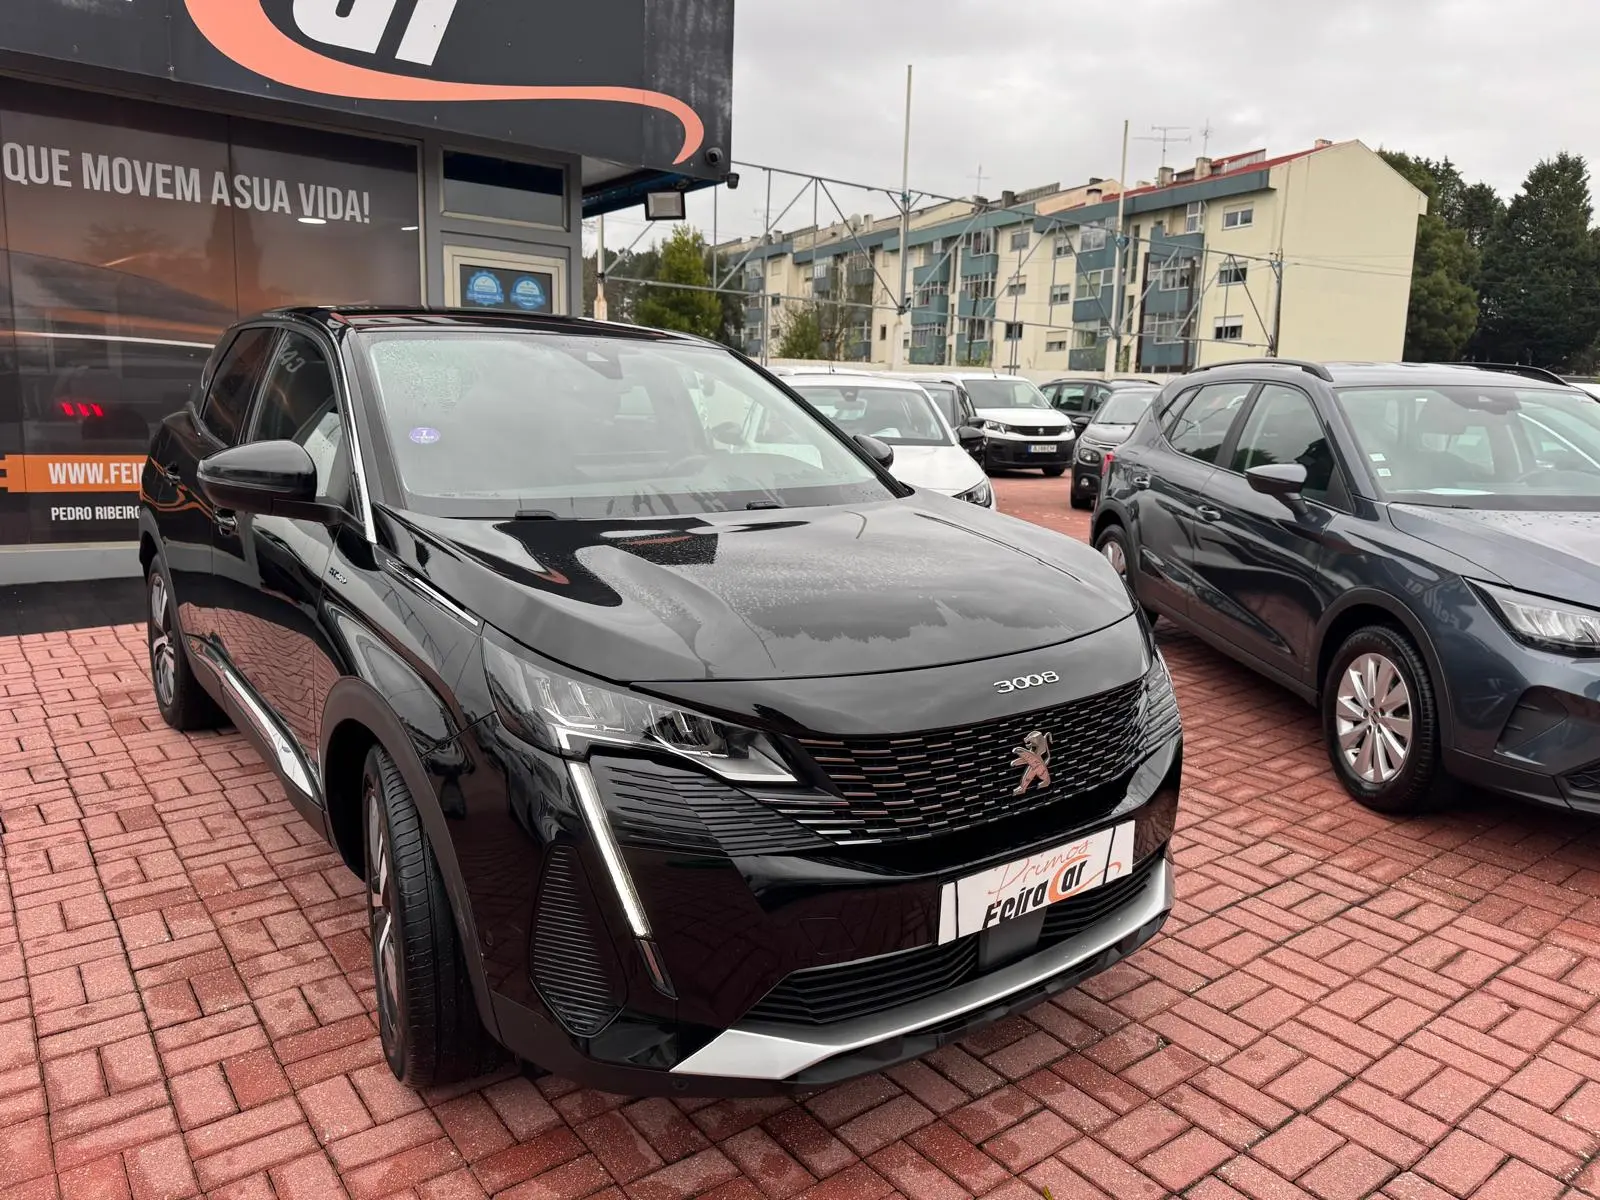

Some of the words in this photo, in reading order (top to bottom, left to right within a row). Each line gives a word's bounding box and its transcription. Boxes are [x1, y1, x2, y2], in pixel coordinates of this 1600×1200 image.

[2, 142, 72, 188] QUE
[81, 152, 202, 204] MOVEM
[298, 182, 371, 225] VIDA!
[50, 506, 92, 521] PEDRO
[993, 670, 1060, 694] 3008
